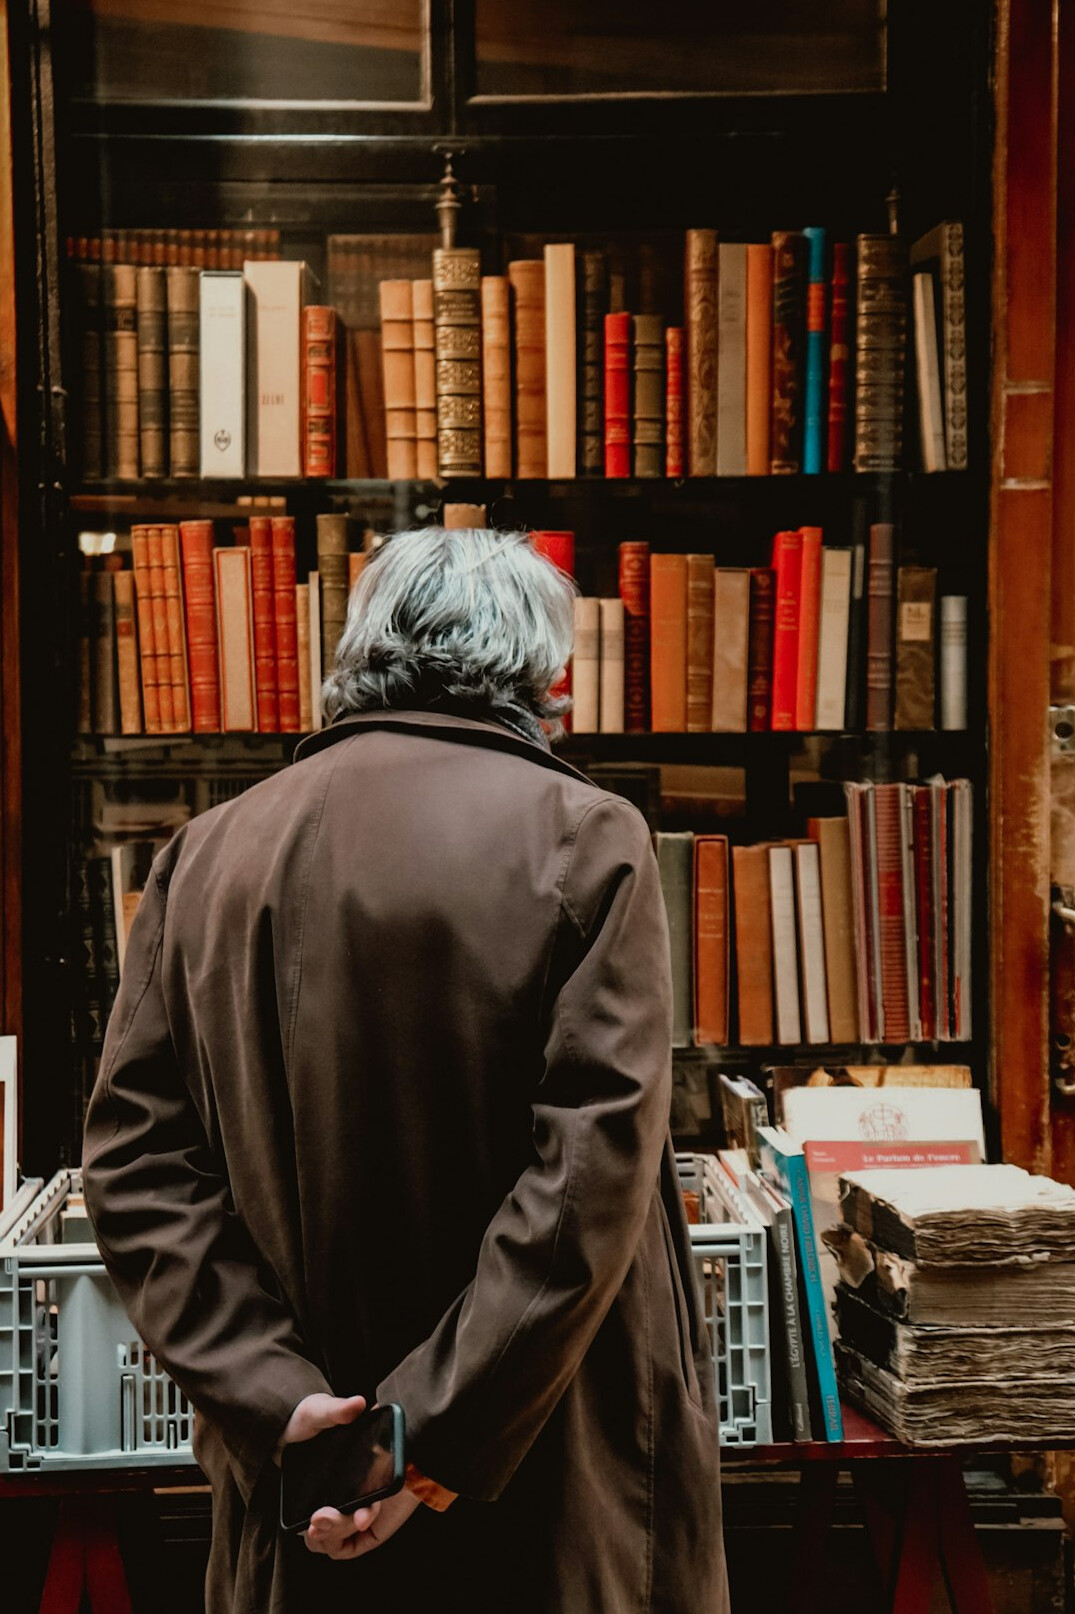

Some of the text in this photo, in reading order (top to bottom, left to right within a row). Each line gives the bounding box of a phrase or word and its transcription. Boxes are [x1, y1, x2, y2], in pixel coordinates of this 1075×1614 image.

[863, 1154, 874, 1163] Le
[779, 1223, 790, 1254] NOIRE
[782, 1255, 795, 1302] CHAMBRE
[786, 1304, 796, 1317] LA
